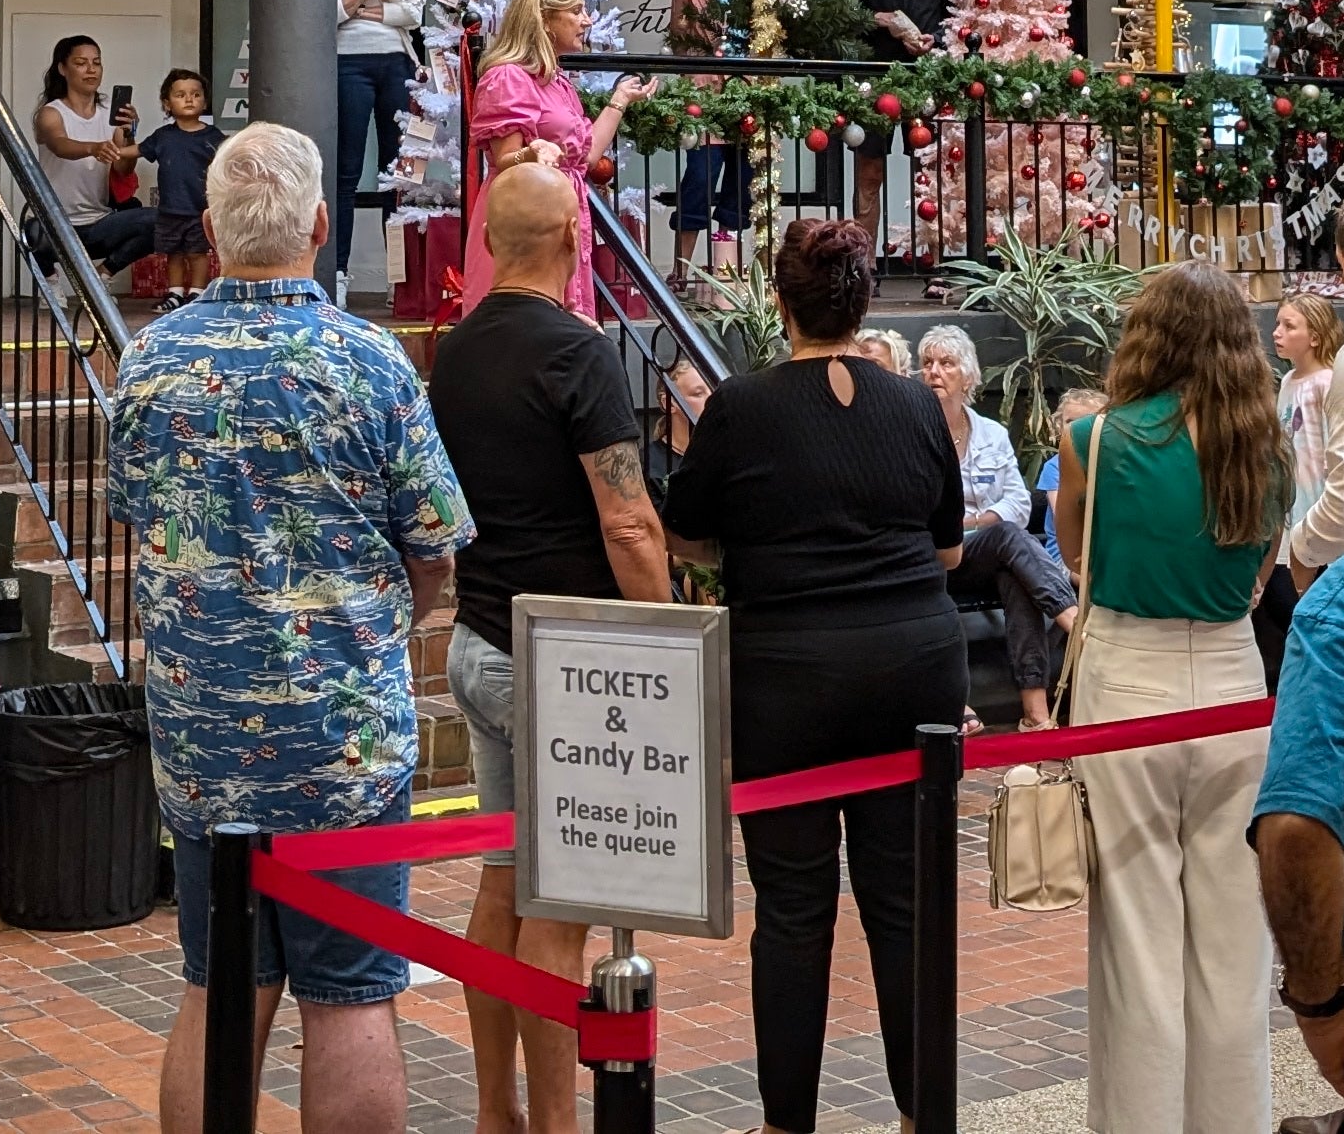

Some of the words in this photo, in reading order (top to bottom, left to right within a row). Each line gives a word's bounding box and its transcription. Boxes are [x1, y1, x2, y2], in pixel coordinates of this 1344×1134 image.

[560, 666, 669, 700] TICKETS
[605, 706, 628, 733] &
[550, 737, 635, 775] Candy
[643, 745, 690, 774] Bar
[556, 796, 628, 824] Please
[634, 803, 678, 831] join
[560, 824, 598, 848] the
[605, 833, 676, 856] queue
